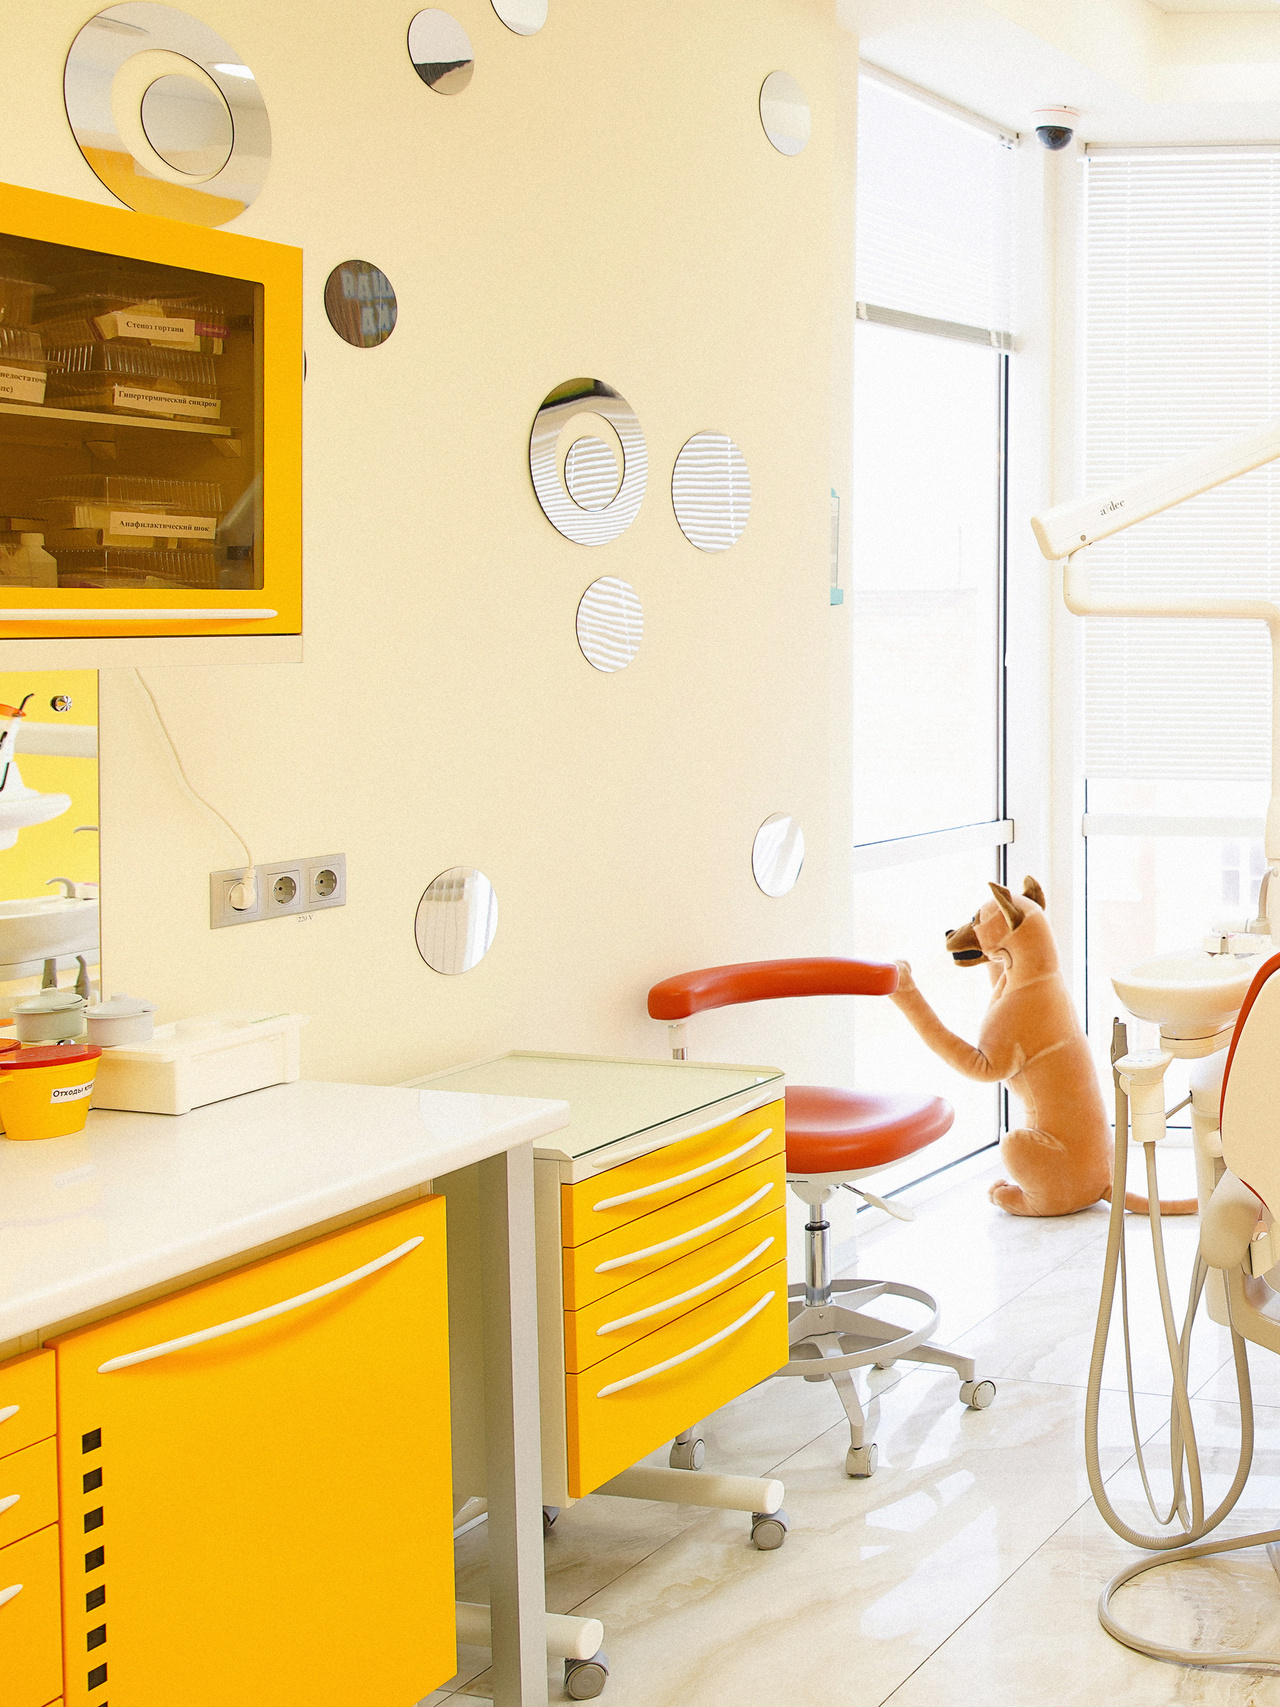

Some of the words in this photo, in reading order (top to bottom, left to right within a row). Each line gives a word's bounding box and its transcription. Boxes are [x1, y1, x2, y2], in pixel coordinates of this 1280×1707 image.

[126, 321, 153, 330] Стеноз
[155, 325, 184, 333] гортани
[118, 390, 187, 404] Гипертермический
[188, 399, 217, 408] синдром
[120, 520, 192, 531] Анафилактический
[53, 1088, 83, 1097] Отходы
